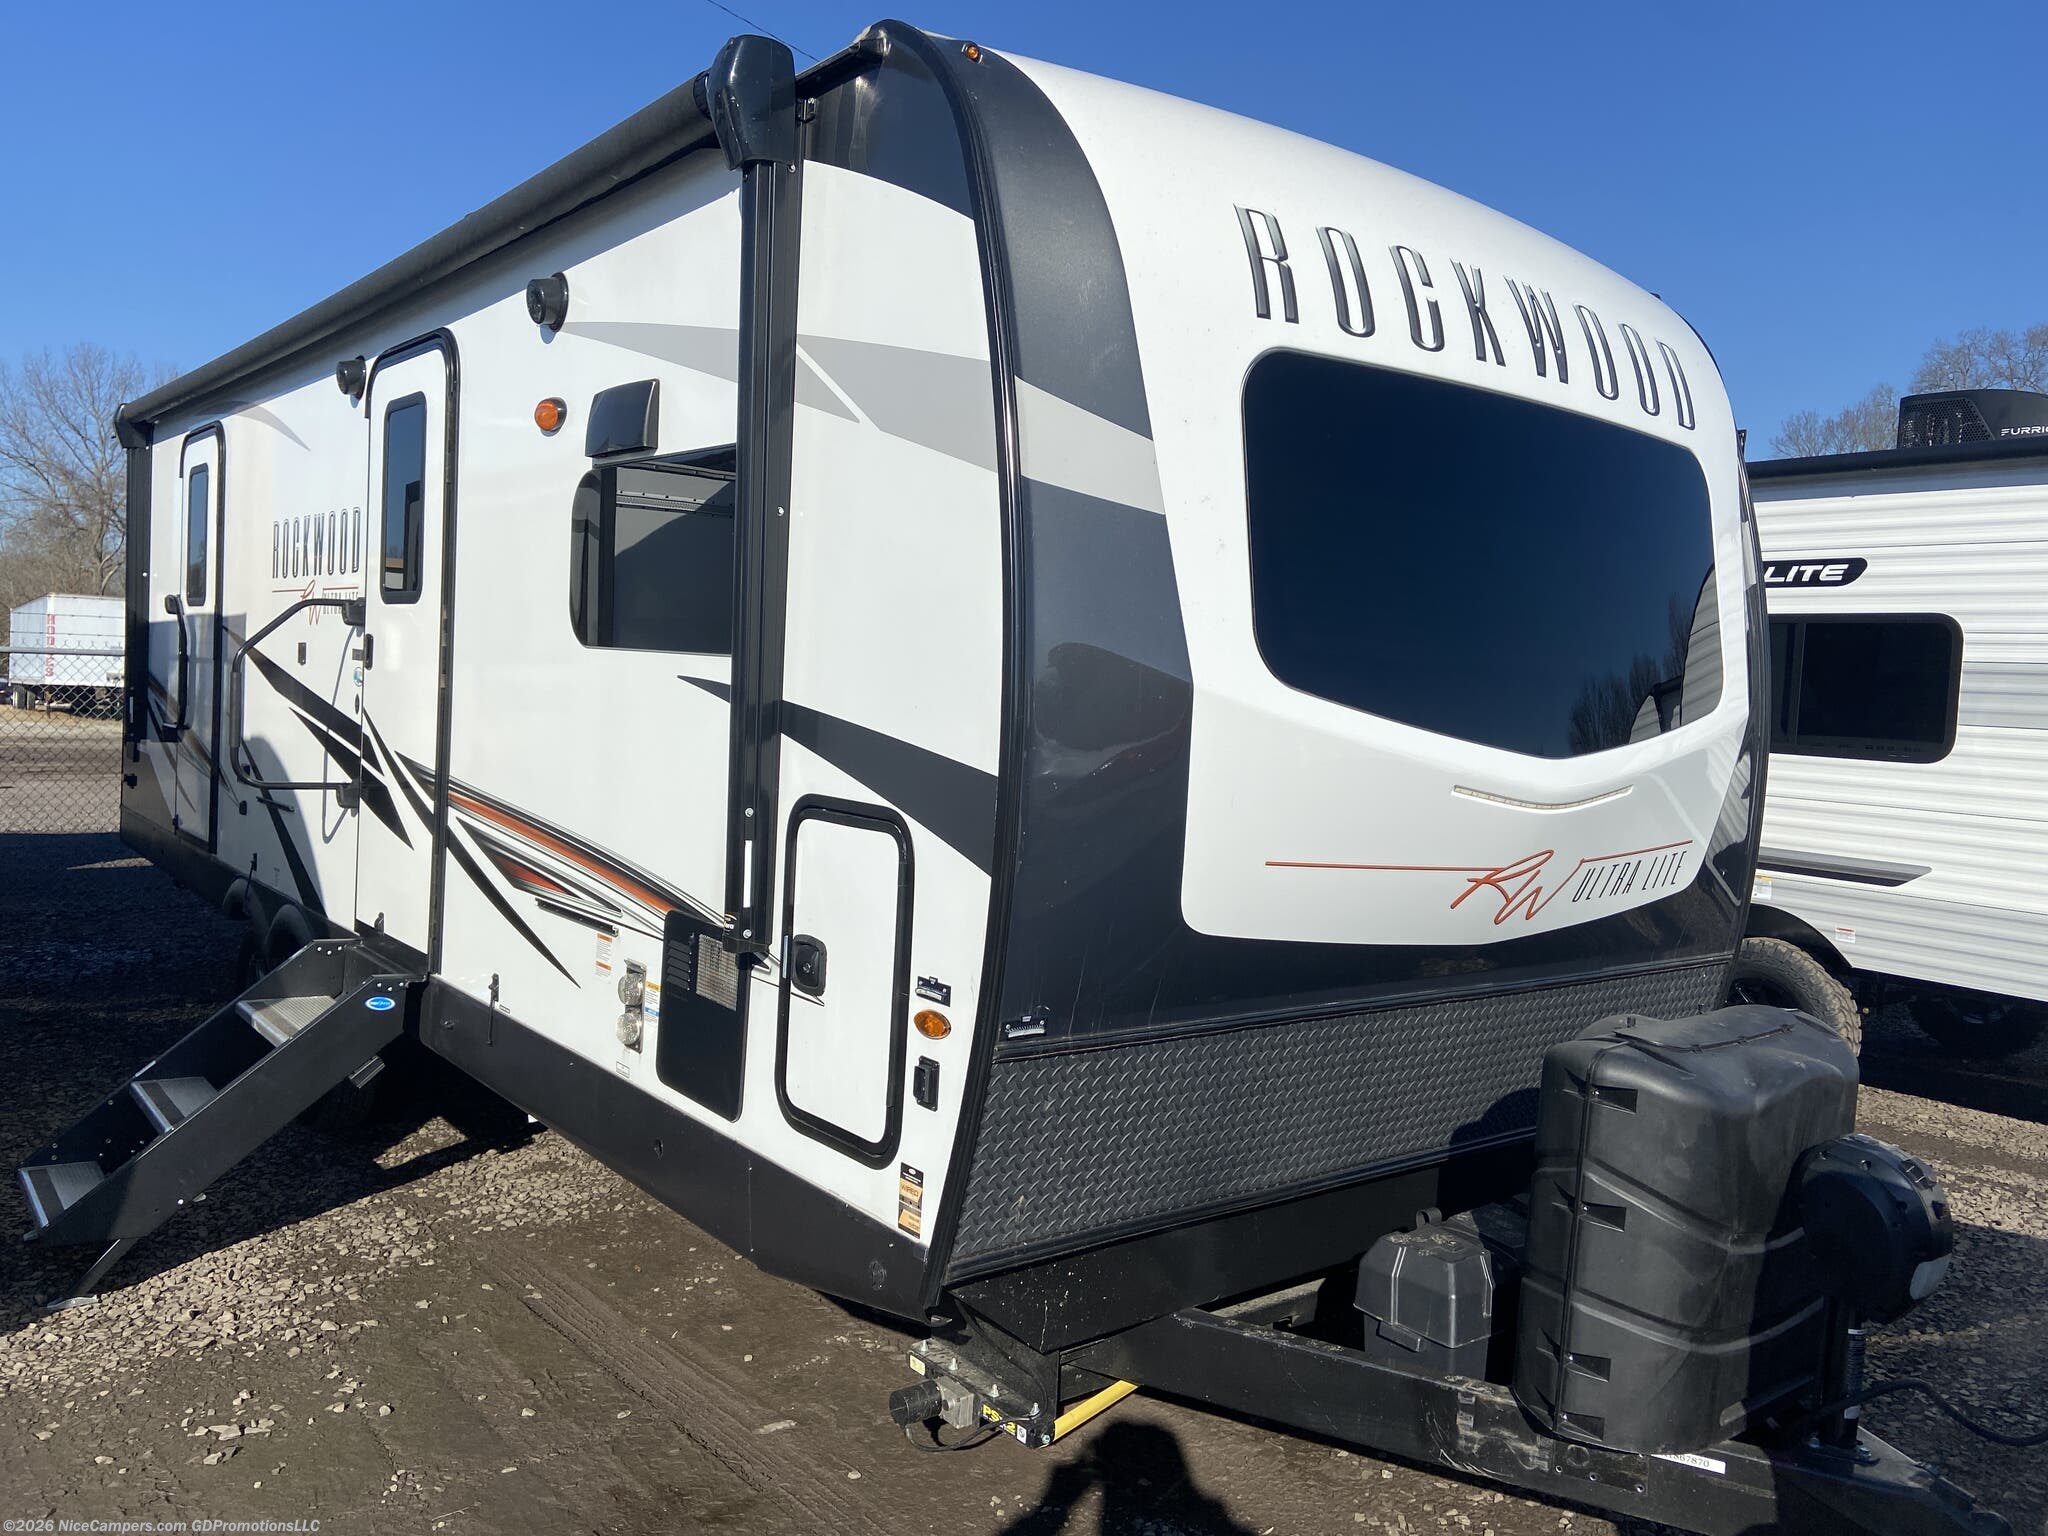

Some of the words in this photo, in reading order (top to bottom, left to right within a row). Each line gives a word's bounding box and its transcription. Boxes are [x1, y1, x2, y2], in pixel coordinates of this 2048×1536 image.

[1232, 201, 1697, 432] ROCKWOOD
[271, 506, 361, 579] ROCKWOOD
[1763, 563, 1850, 583] LITE
[1571, 859, 1643, 903] ULTRA
[1641, 850, 1688, 891] LITE
[982, 1403, 1017, 1435] PS2
